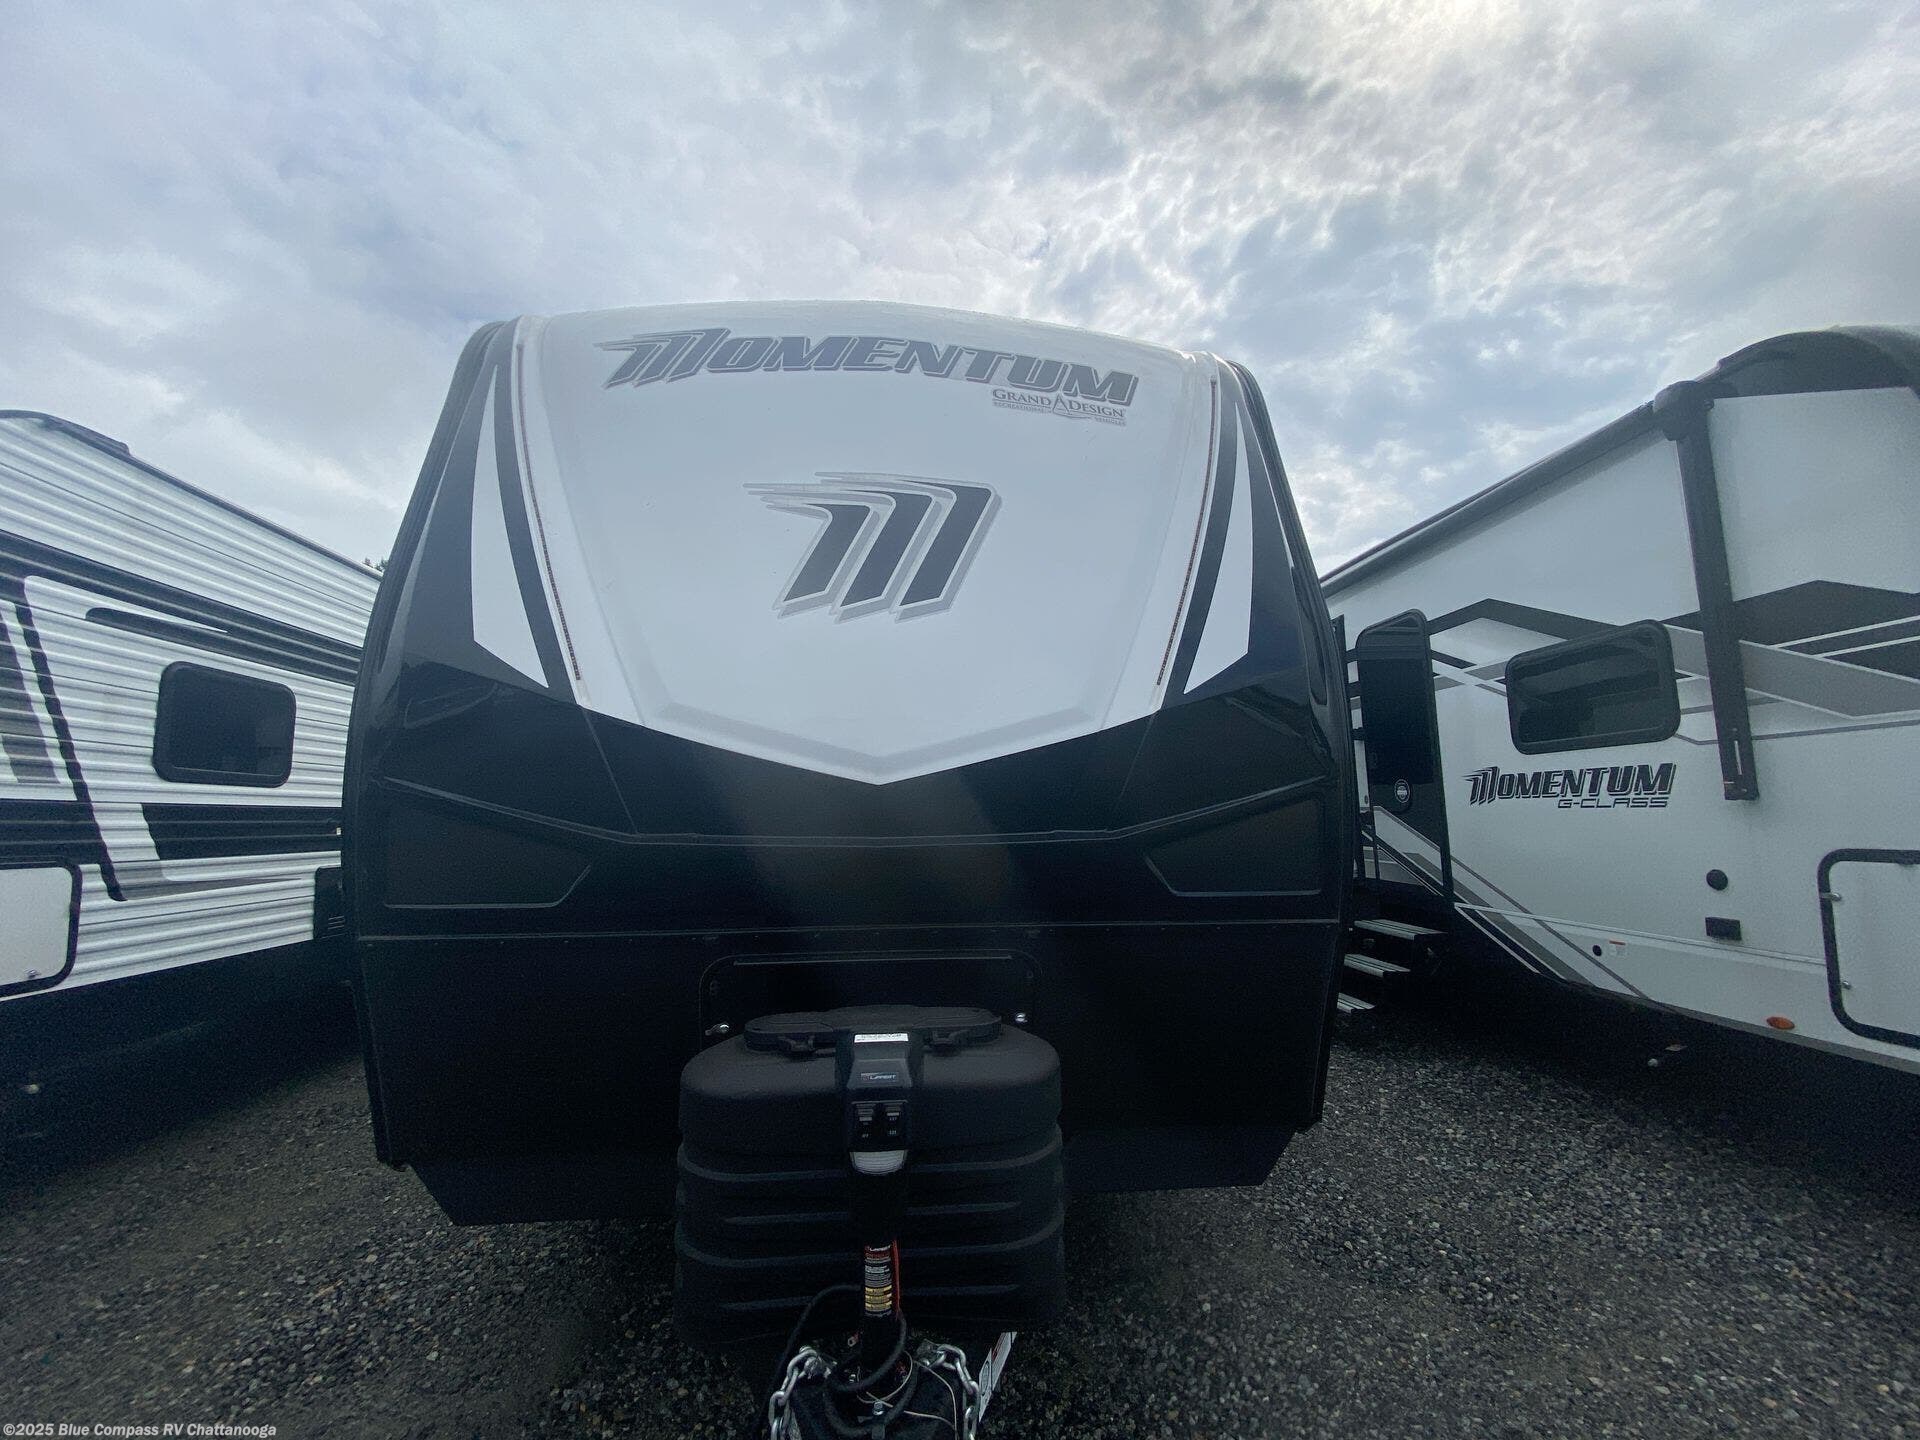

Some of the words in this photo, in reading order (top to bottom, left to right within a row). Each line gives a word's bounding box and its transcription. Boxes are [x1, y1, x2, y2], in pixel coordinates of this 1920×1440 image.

[593, 328, 1139, 406] MOMENTUM
[992, 388, 1052, 406] GRAND
[1069, 400, 1125, 418] DESIGN
[1461, 763, 1676, 805] MOMENTUM
[1557, 797, 1669, 809] G-CLASS
